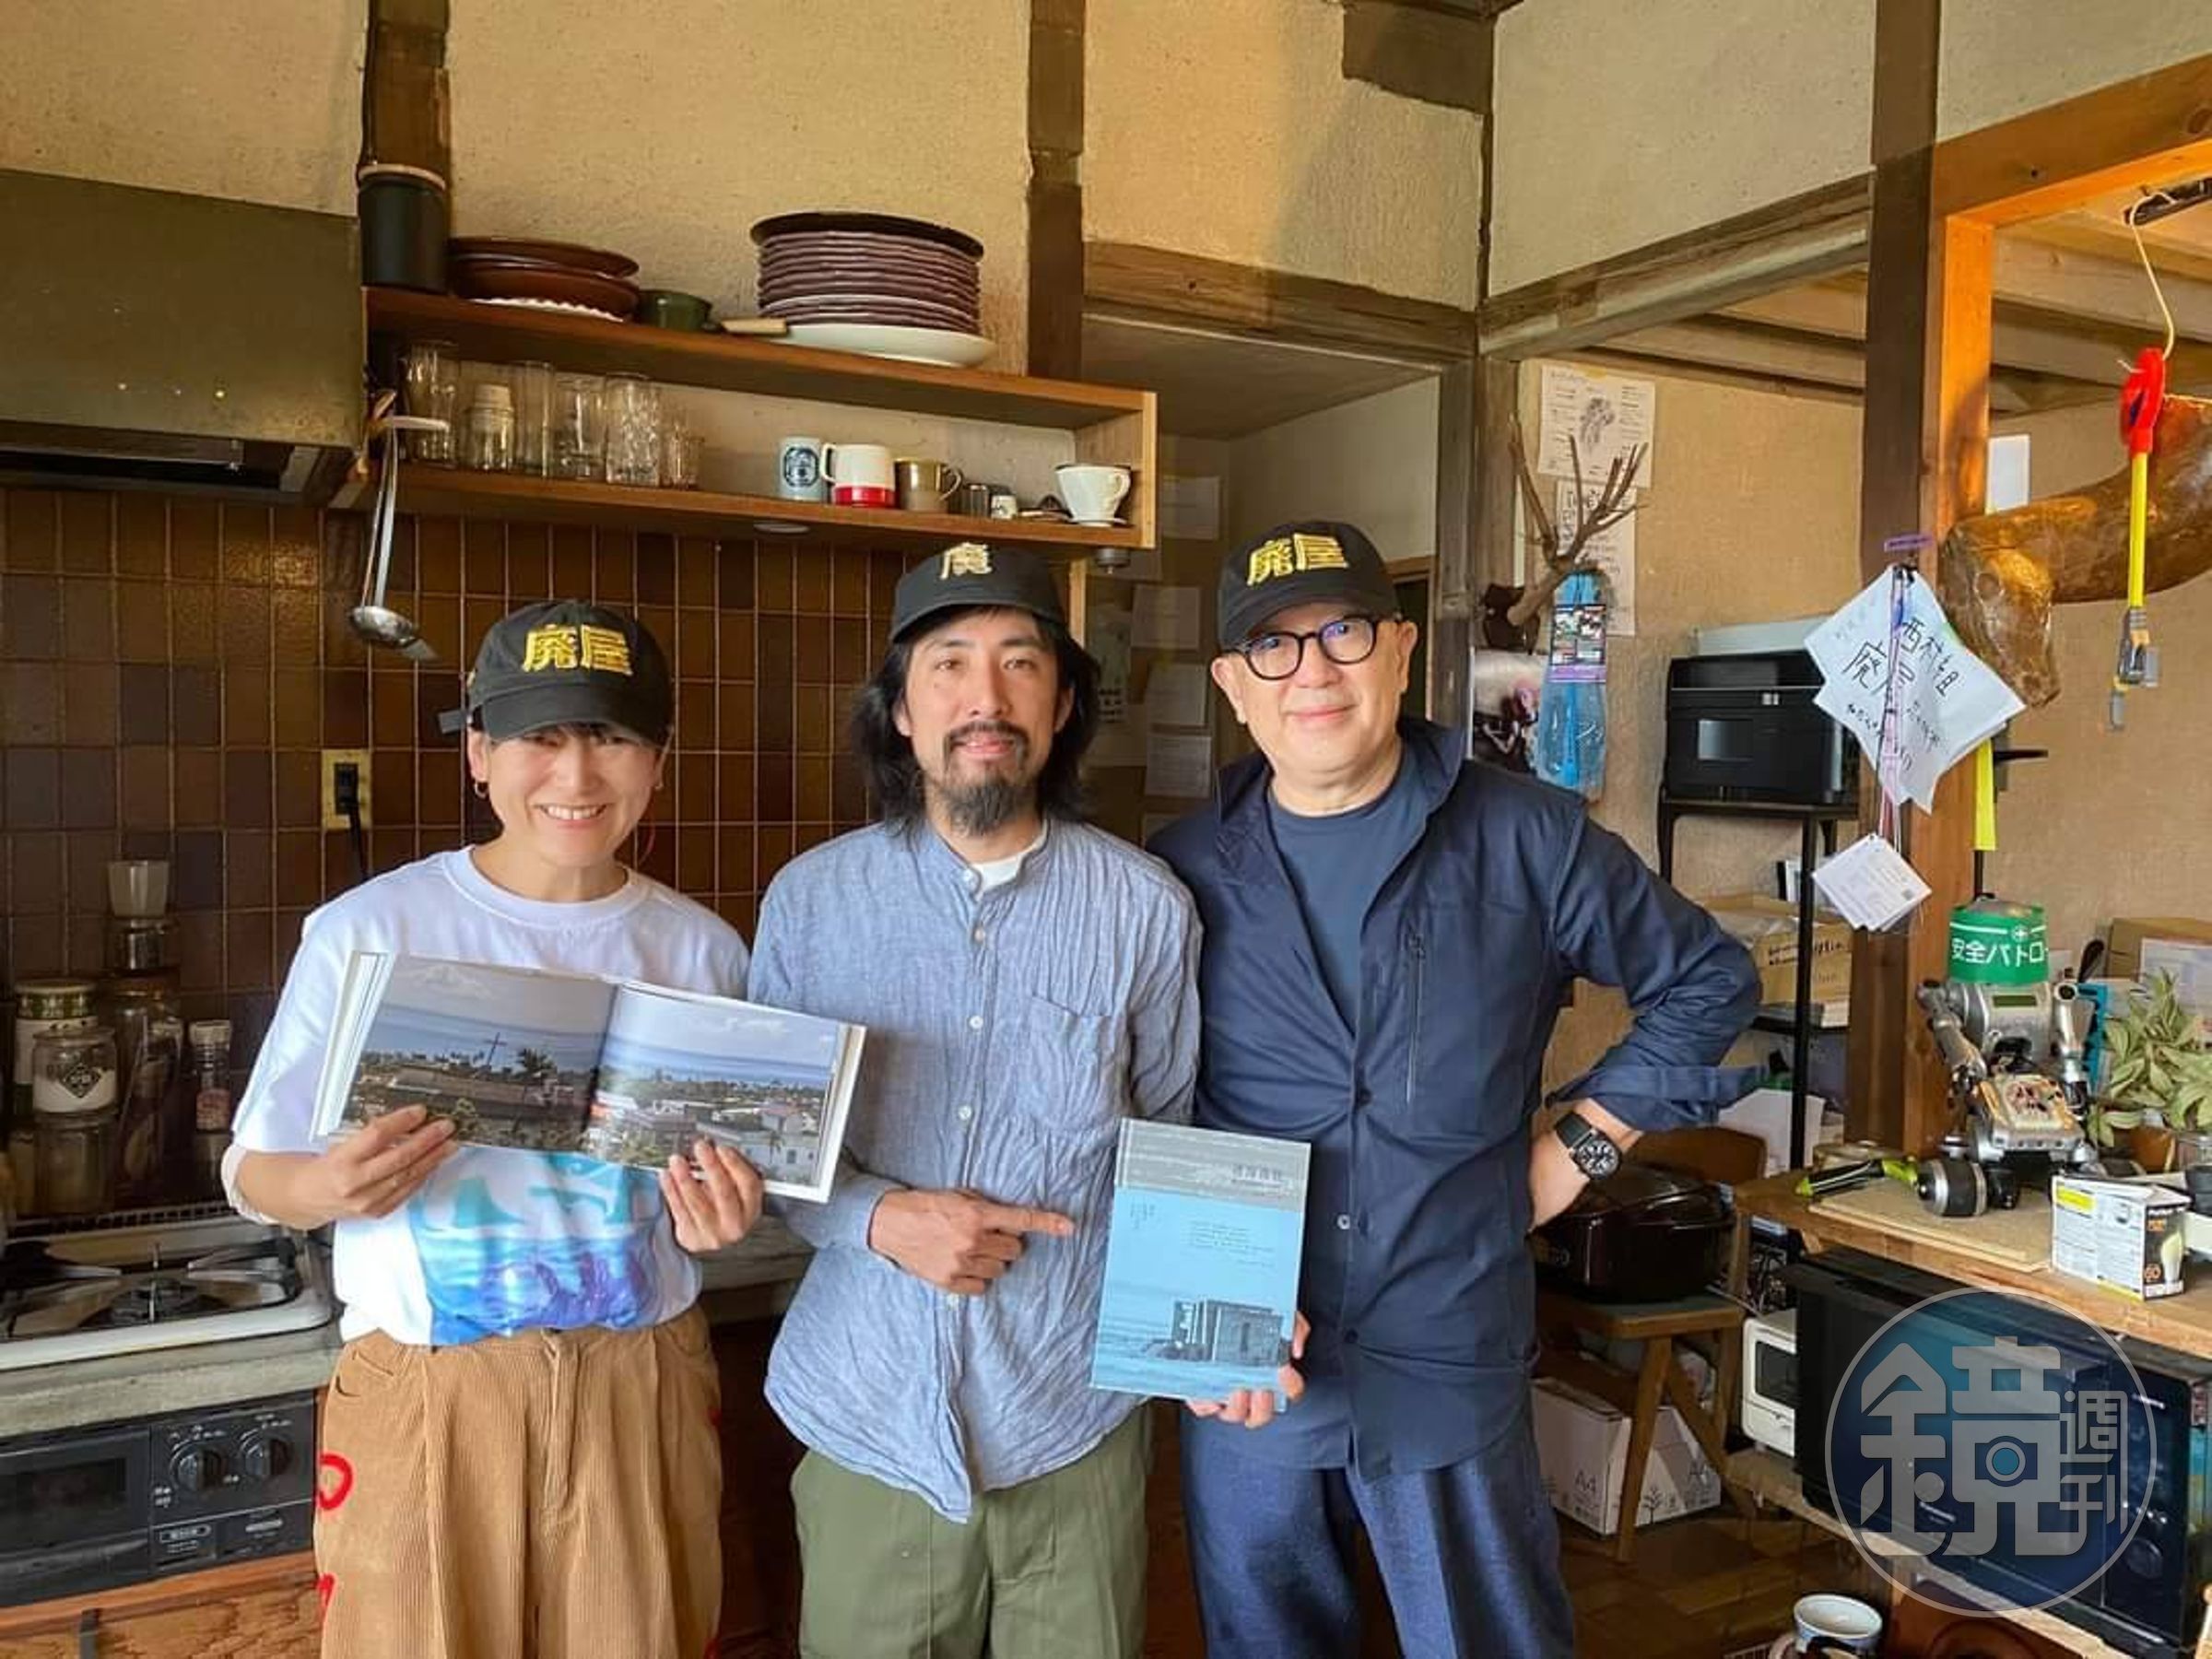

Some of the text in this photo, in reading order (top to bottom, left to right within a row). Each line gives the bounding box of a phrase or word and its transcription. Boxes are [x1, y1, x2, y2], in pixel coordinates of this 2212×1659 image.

[1951, 937, 2049, 968] 安全パトロ
